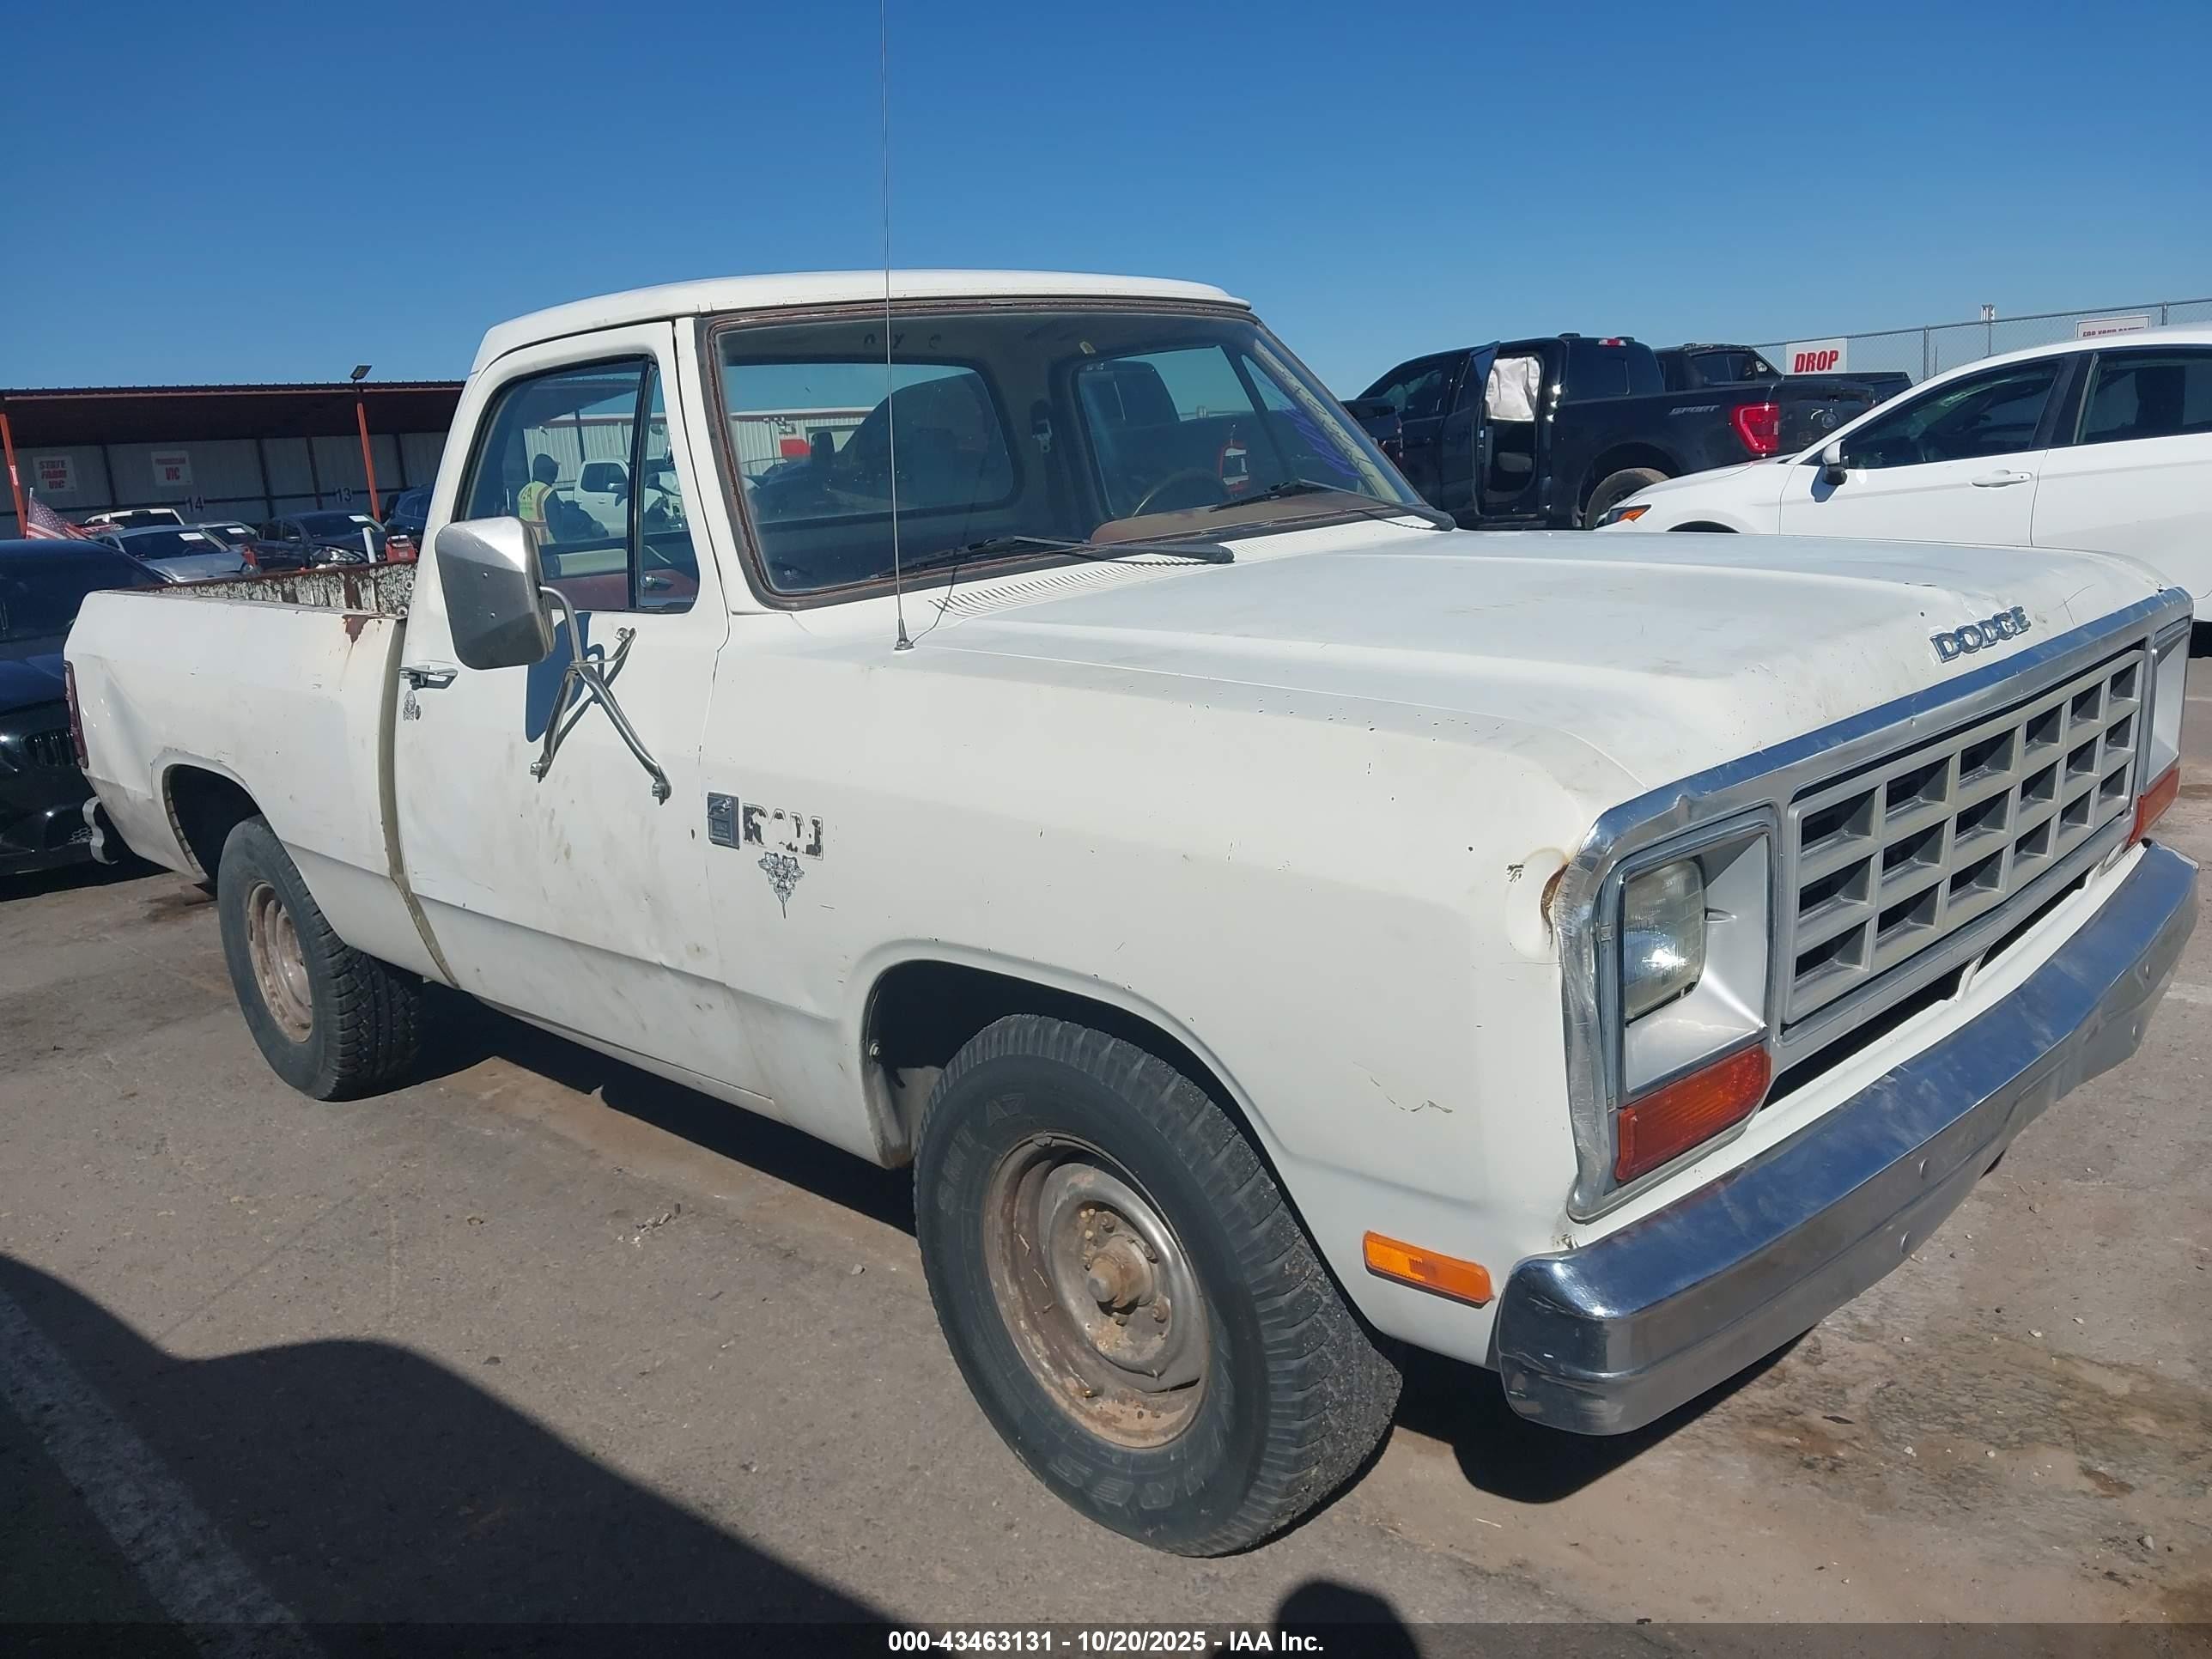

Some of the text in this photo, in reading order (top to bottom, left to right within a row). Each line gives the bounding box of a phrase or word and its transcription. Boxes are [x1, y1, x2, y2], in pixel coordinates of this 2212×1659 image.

[1794, 349, 1839, 373] DROP
[1668, 404, 1720, 416] SPORT
[165, 466, 180, 481] VIC
[335, 489, 353, 502] 13
[185, 495, 205, 513] 14
[1929, 605, 2032, 664] DODGE
